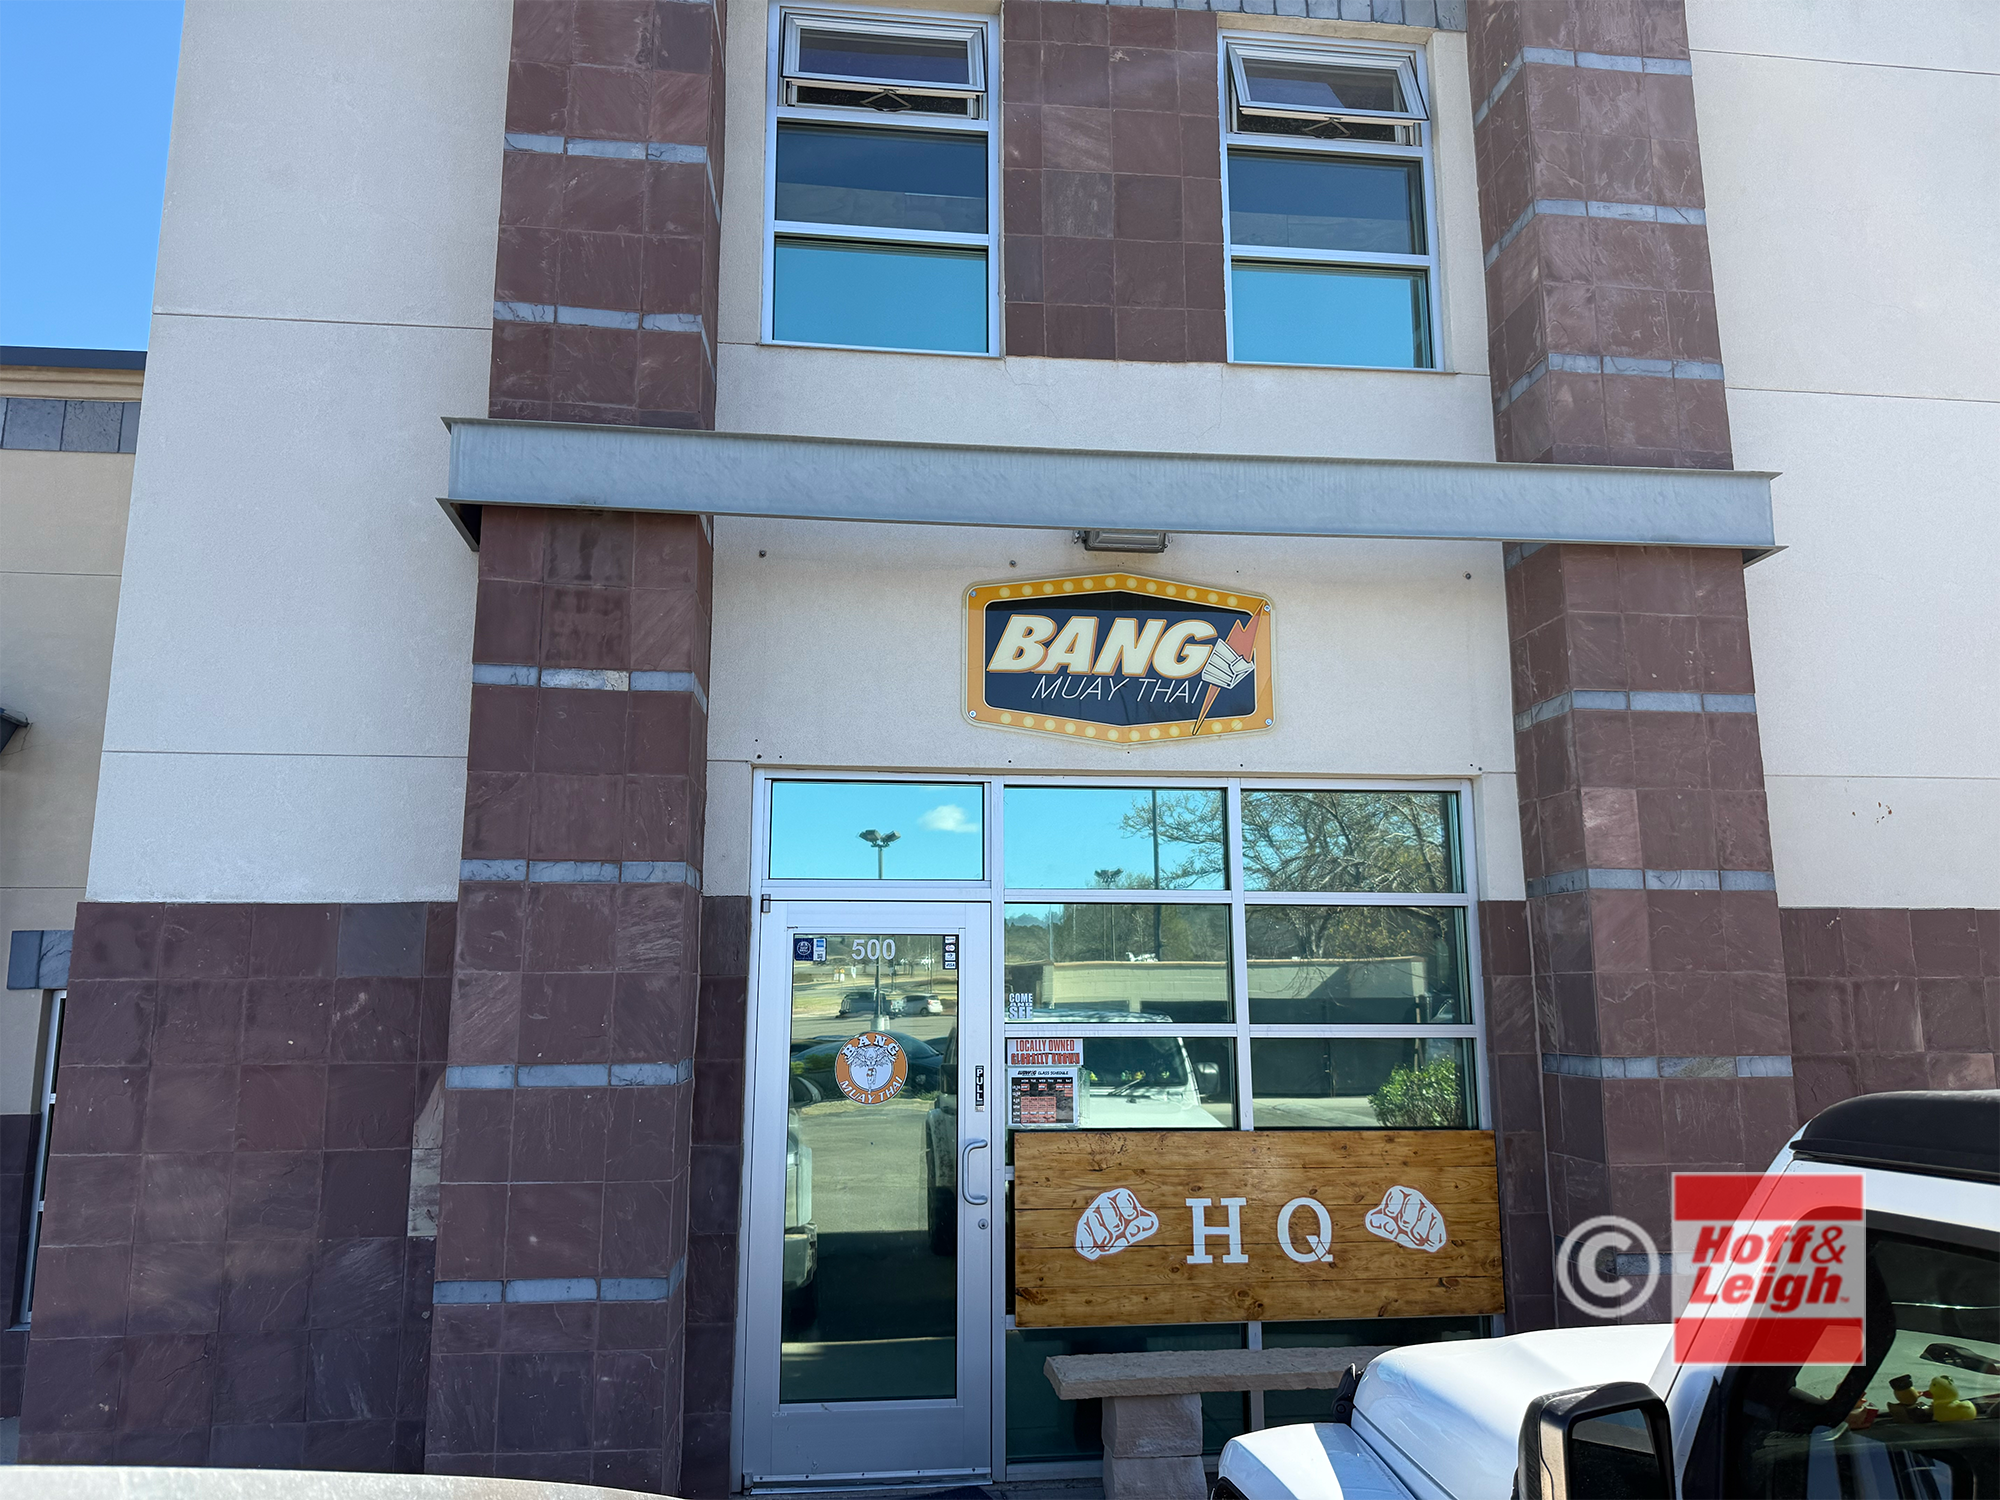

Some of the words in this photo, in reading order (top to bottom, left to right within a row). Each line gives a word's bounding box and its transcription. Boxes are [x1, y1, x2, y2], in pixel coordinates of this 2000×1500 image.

[986, 614, 1218, 679] BANG
[1031, 675, 1130, 701] MUAY
[1136, 678, 1204, 704] THAI
[851, 938, 896, 960] 500
[1009, 992, 1033, 1003] COME
[1009, 1007, 1033, 1019] SEE
[842, 1035, 899, 1058] BANG
[1016, 1040, 1047, 1052] LOCALLY
[1049, 1040, 1075, 1052] OWNED
[1011, 1053, 1049, 1065] GLOBALLY
[1051, 1053, 1080, 1065] KNOWN
[840, 1080, 876, 1103] MUAY
[879, 1076, 903, 1101] THAI
